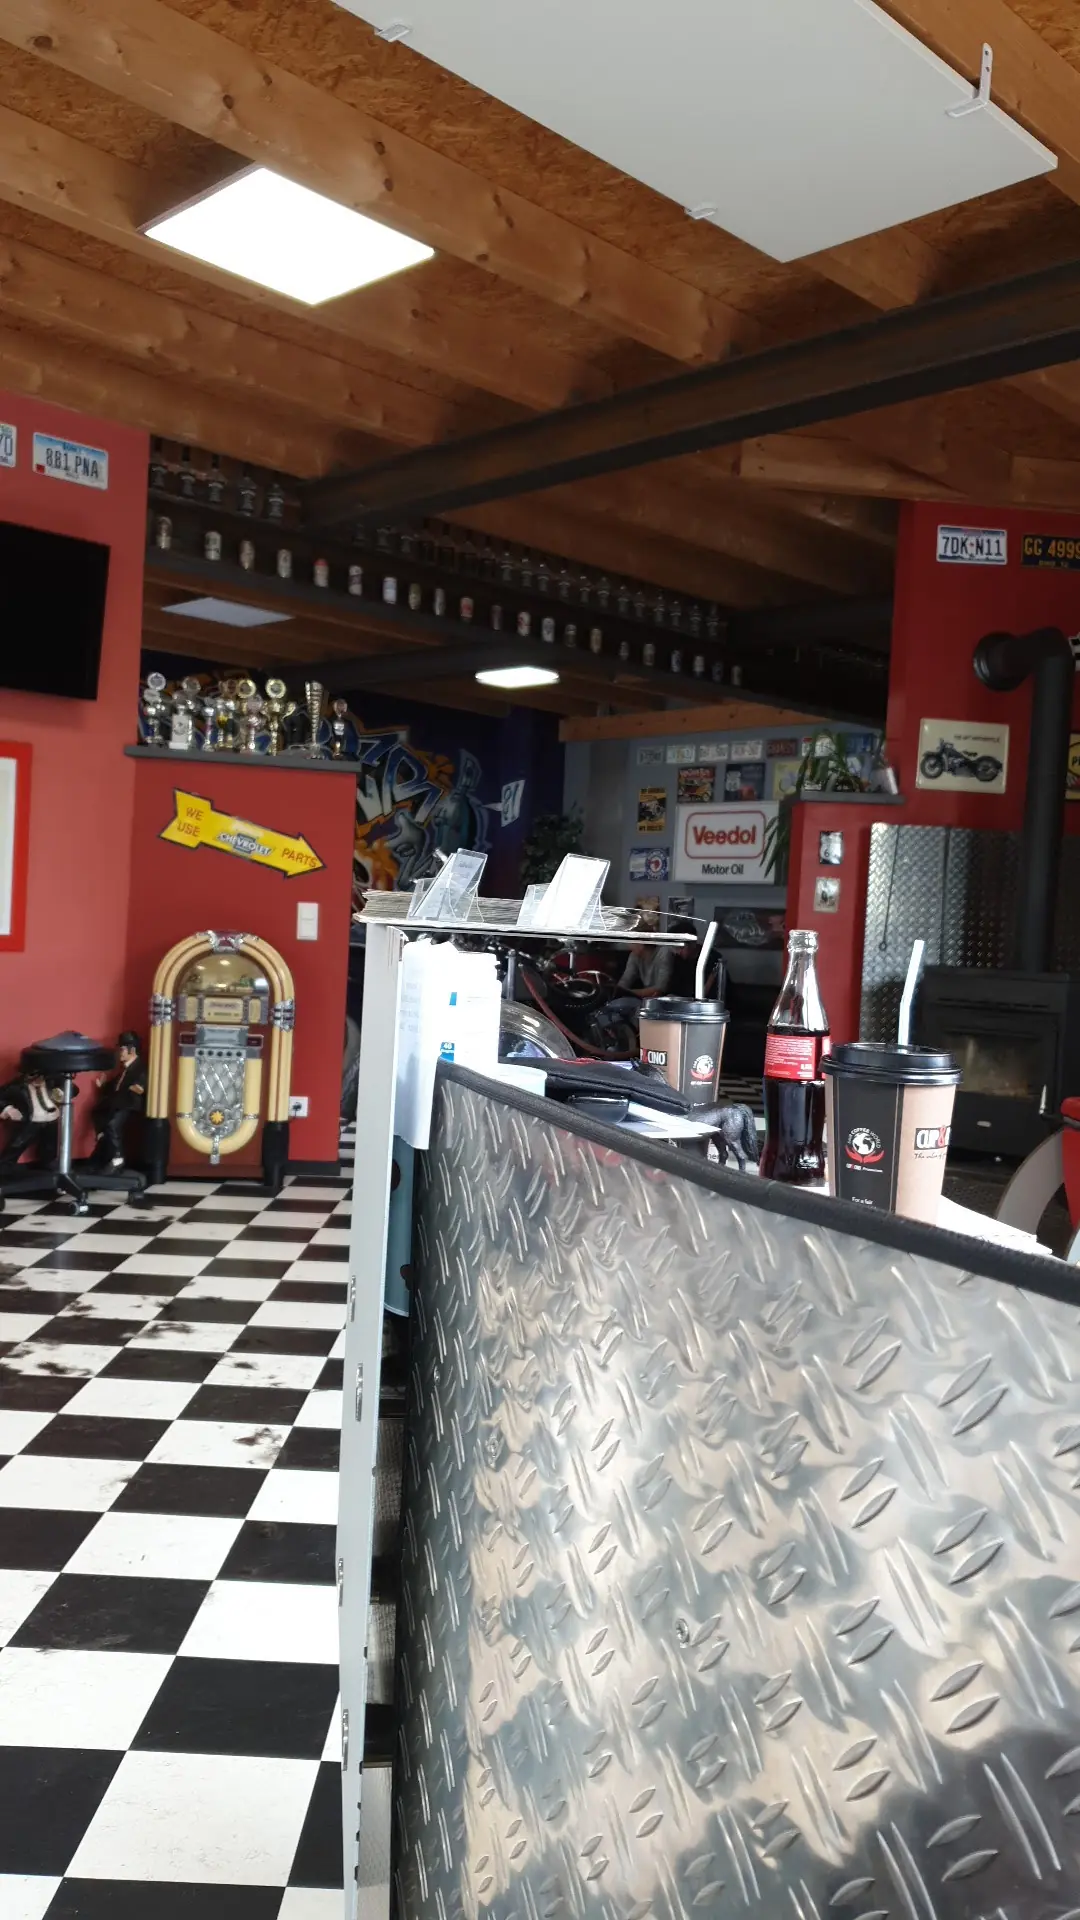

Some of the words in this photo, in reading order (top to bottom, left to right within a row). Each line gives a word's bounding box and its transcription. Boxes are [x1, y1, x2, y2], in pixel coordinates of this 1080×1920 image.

[75, 456, 99, 479] PNA
[185, 807, 204, 822] WE
[177, 820, 201, 838] USE
[692, 824, 757, 846] Veedol
[219, 832, 274, 857] CHEVROLET
[281, 847, 318, 868] PARTS
[701, 863, 728, 875] Motor
[730, 862, 744, 875] Oil
